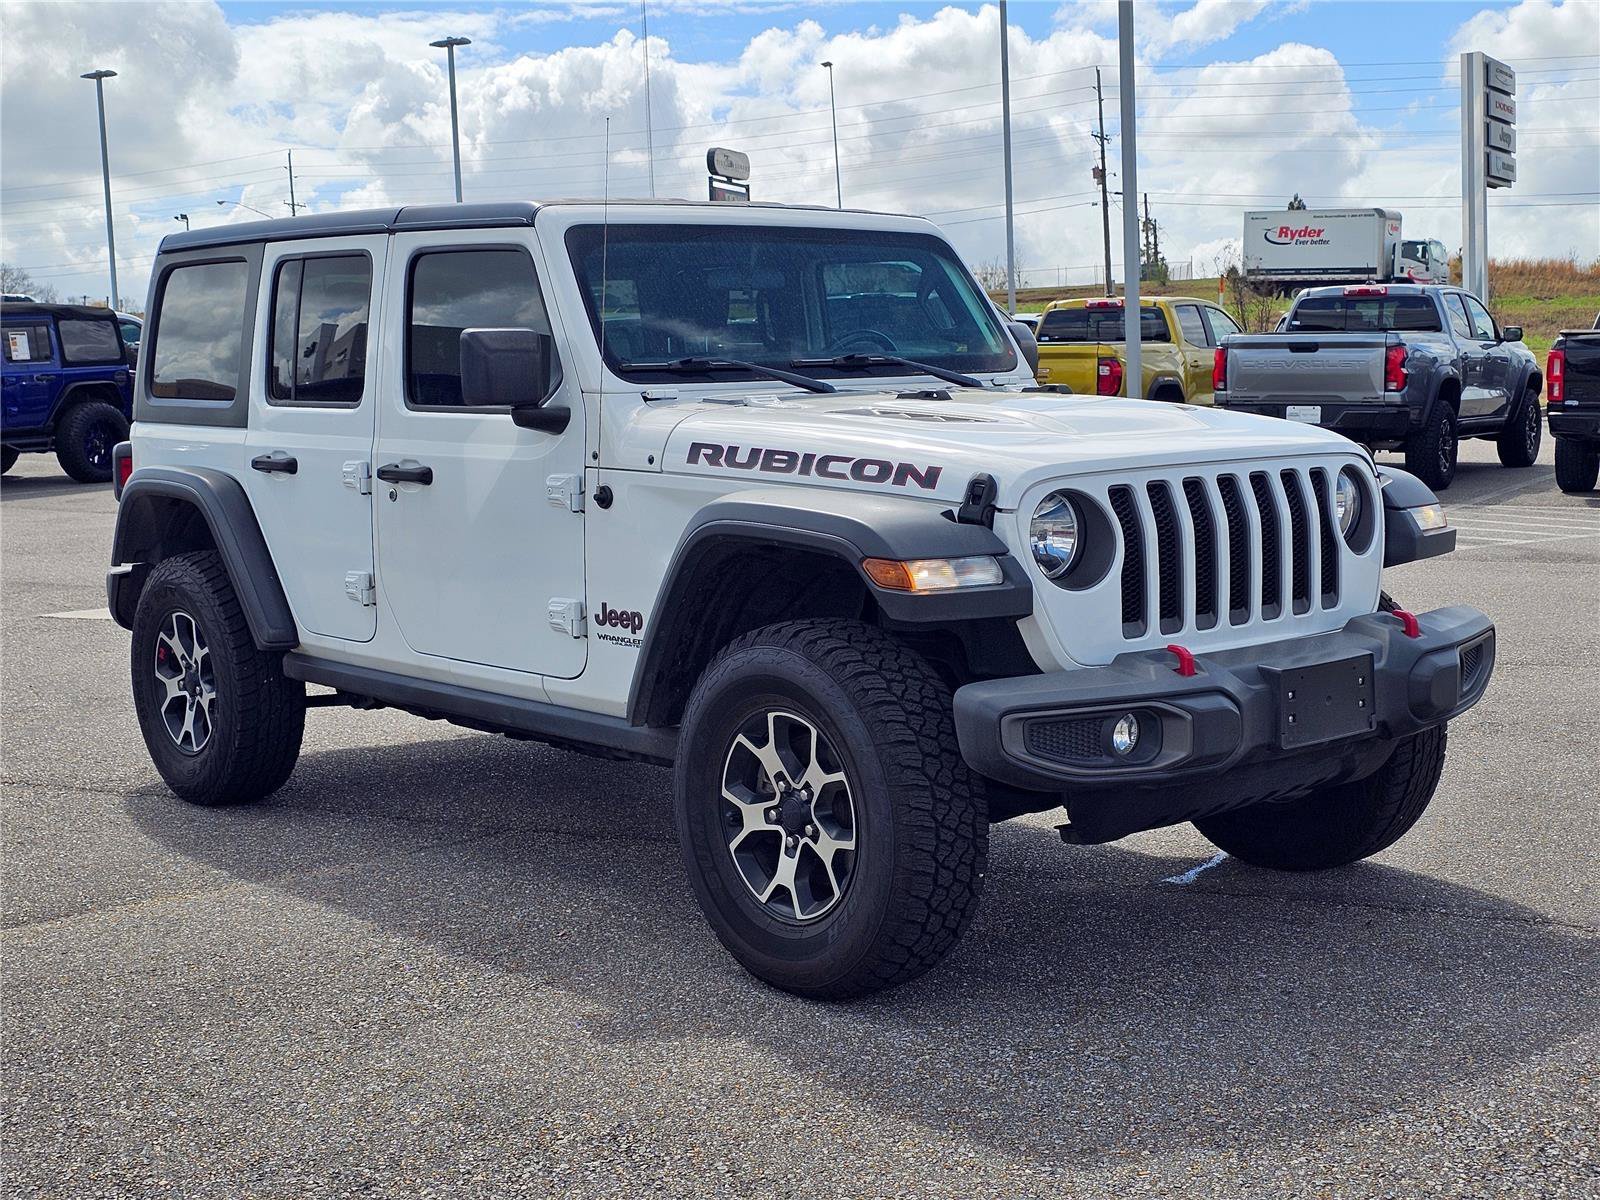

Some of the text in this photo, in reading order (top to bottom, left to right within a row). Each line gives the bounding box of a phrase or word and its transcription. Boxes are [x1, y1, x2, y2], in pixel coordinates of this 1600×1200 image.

[1495, 100, 1514, 116] DODGE
[1277, 226, 1325, 241] Ryder
[1241, 359, 1367, 370] CHEVROLET
[686, 442, 943, 490] RUBICON
[594, 601, 643, 635] Jeep
